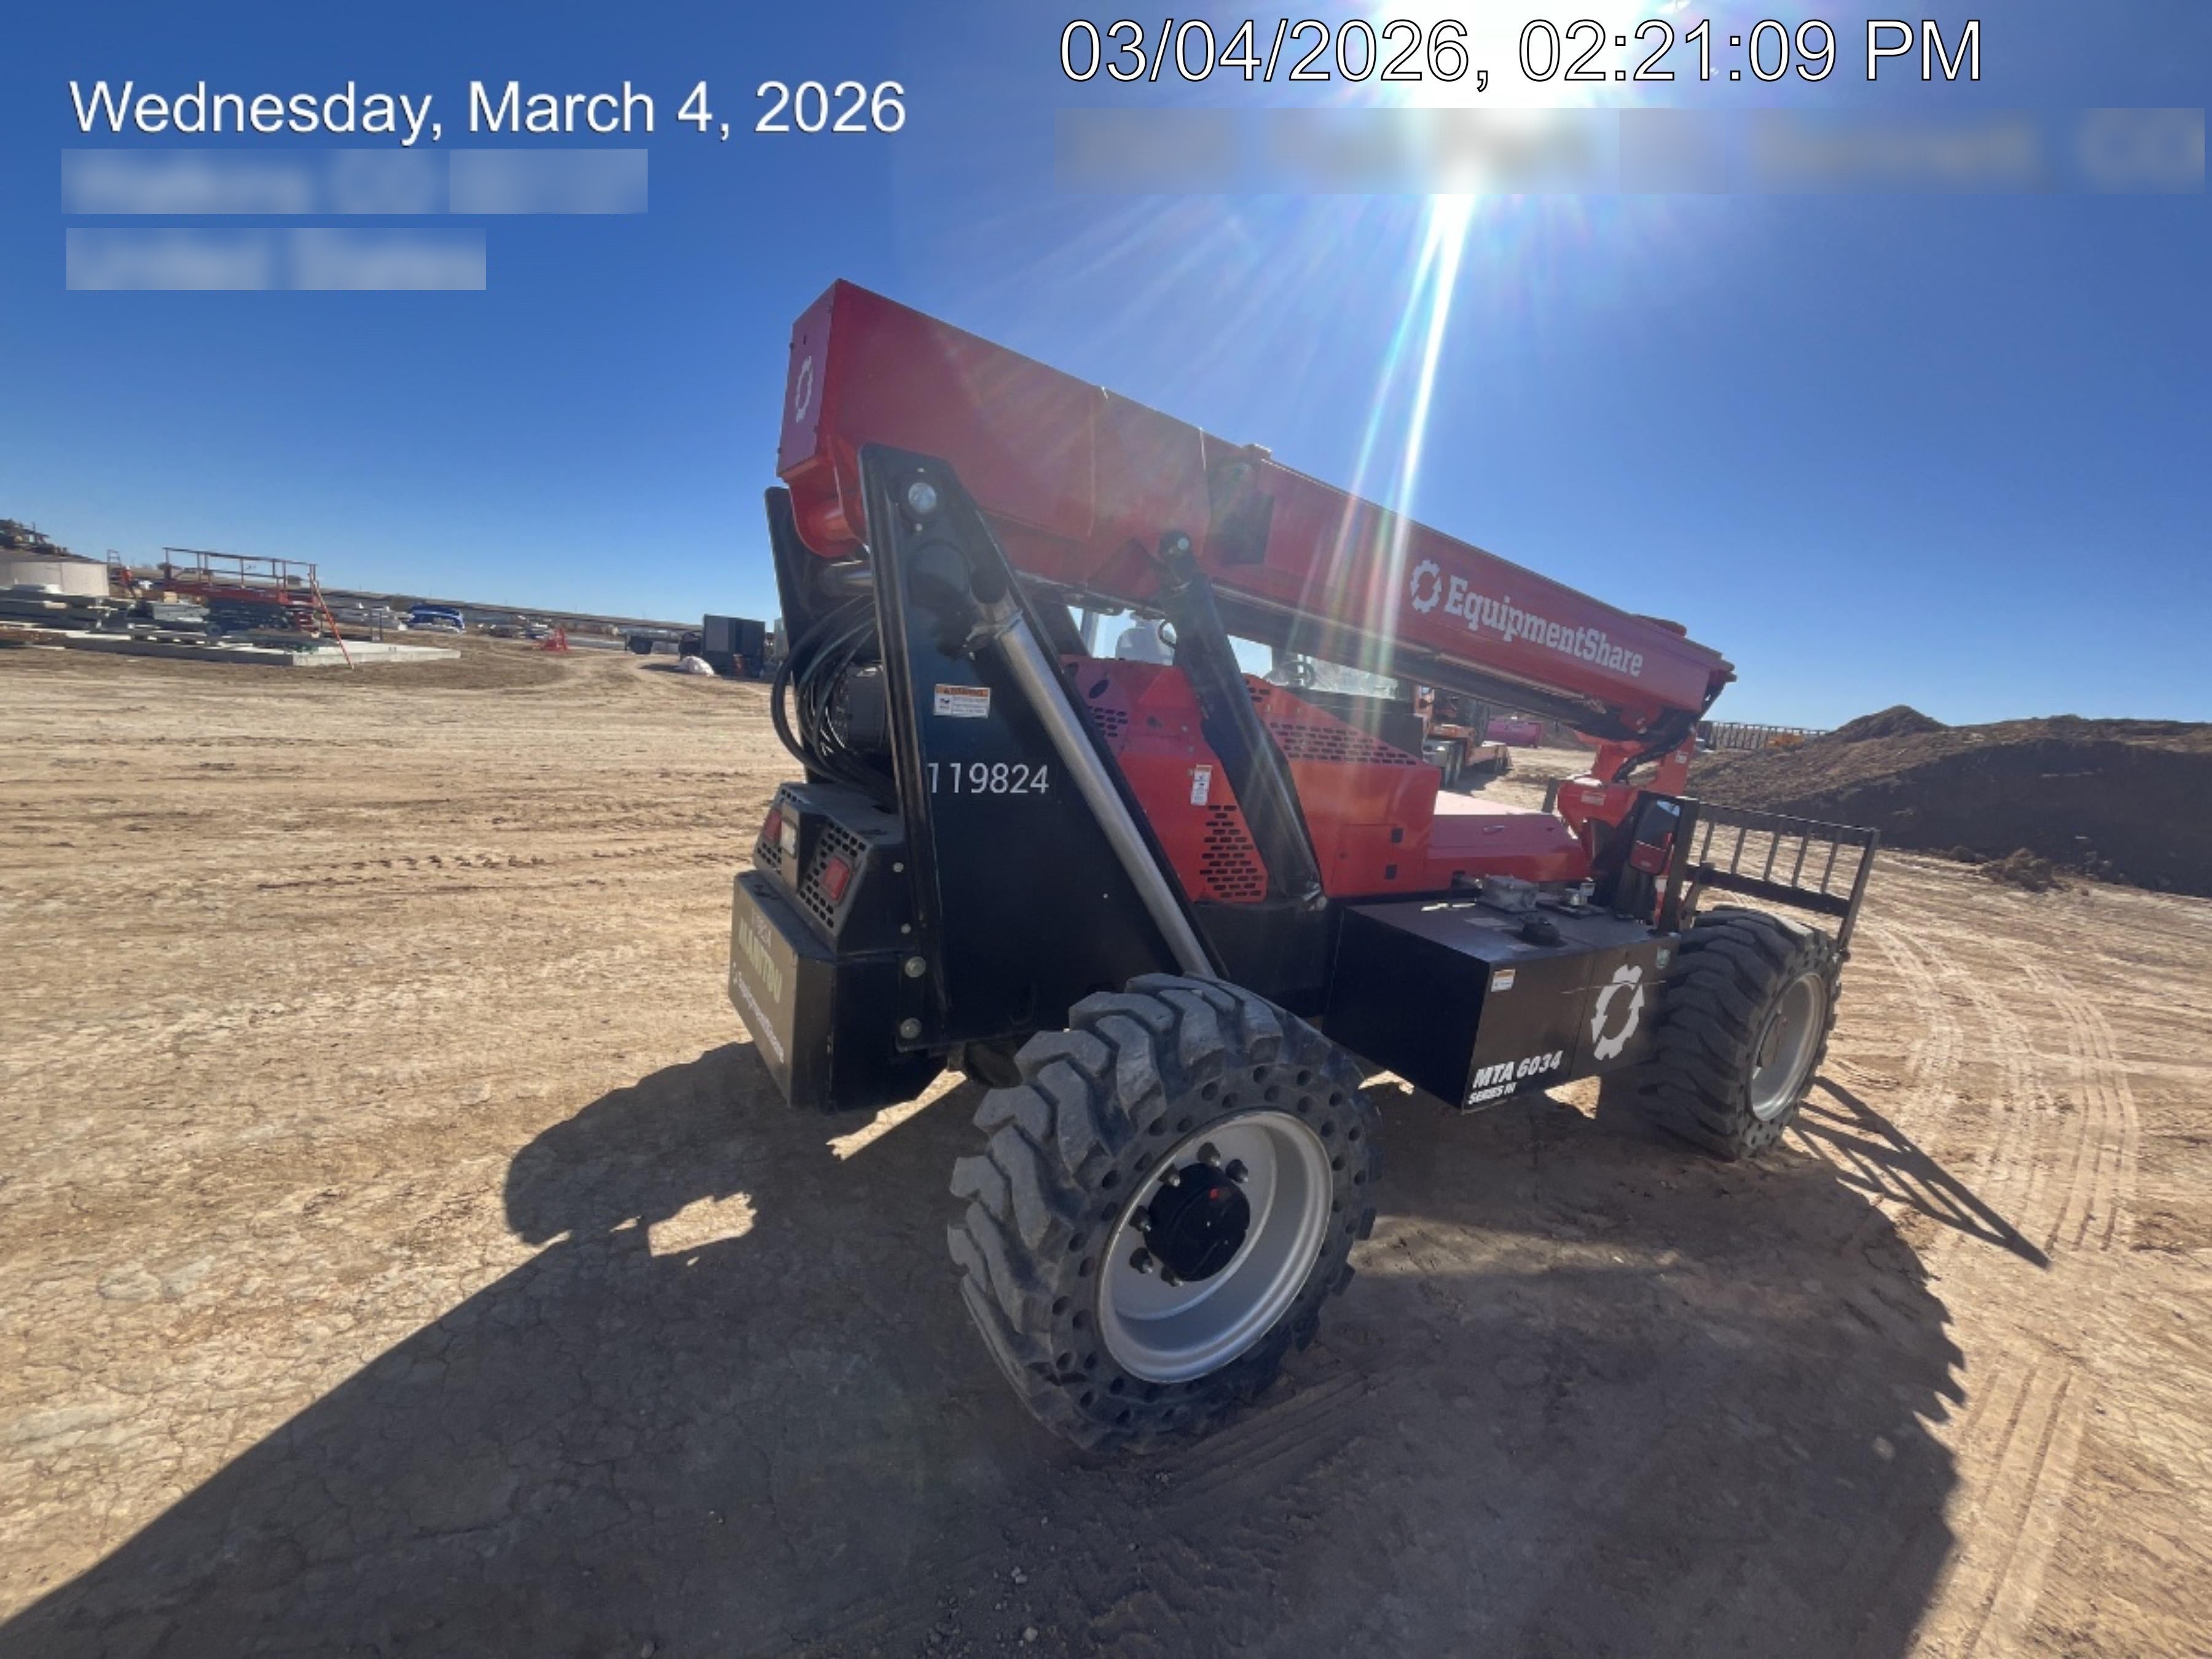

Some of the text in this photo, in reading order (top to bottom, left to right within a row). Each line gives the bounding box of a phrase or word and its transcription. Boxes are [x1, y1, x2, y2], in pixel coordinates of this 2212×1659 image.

[1445, 575, 1644, 677] EquipmentShare
[927, 762, 1049, 794] 119824
[1473, 1050, 1564, 1089] MTA 6034
